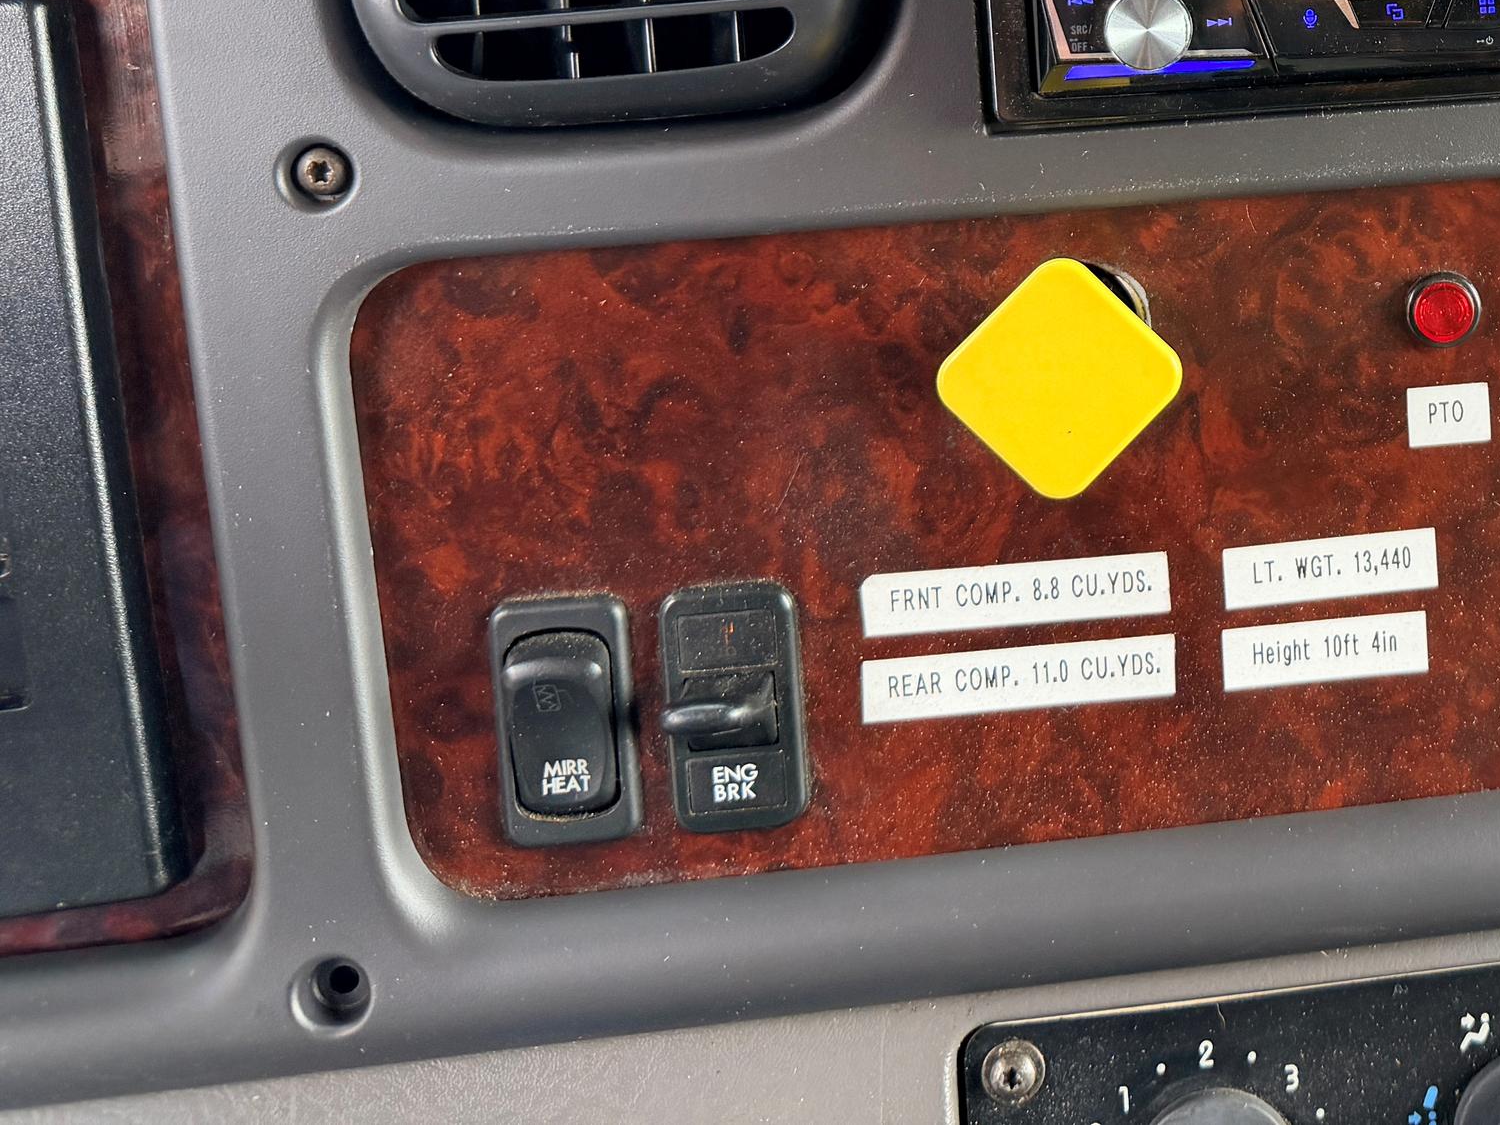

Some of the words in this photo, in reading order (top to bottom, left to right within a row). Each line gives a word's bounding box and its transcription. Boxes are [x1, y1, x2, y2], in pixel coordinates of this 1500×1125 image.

[1071, 41, 1088, 52] OFF
[1428, 400, 1465, 424] PTO
[1252, 560, 1282, 583] LT.
[1295, 555, 1341, 579] WGT.
[1353, 546, 1412, 575] 13,440
[889, 586, 942, 612] FRNT
[955, 581, 1022, 607] COMP.
[1032, 577, 1061, 603] 8.8
[1071, 569, 1153, 597] CU.YDS.
[1252, 638, 1311, 666] Height
[1323, 632, 1360, 658] 10ft
[1371, 631, 1398, 653] 4in
[887, 673, 943, 699] REAR
[954, 665, 1019, 692] COMP.
[1031, 659, 1069, 684] 11.0
[1080, 653, 1162, 679] CU.YDS.
[543, 758, 588, 776] MIRR
[711, 763, 759, 784] ENG
[541, 775, 592, 796] HEAT
[713, 781, 757, 803] BRK
[1198, 1039, 1215, 1069] 2
[1284, 1063, 1299, 1092] 3
[1118, 1085, 1130, 1115] 1
